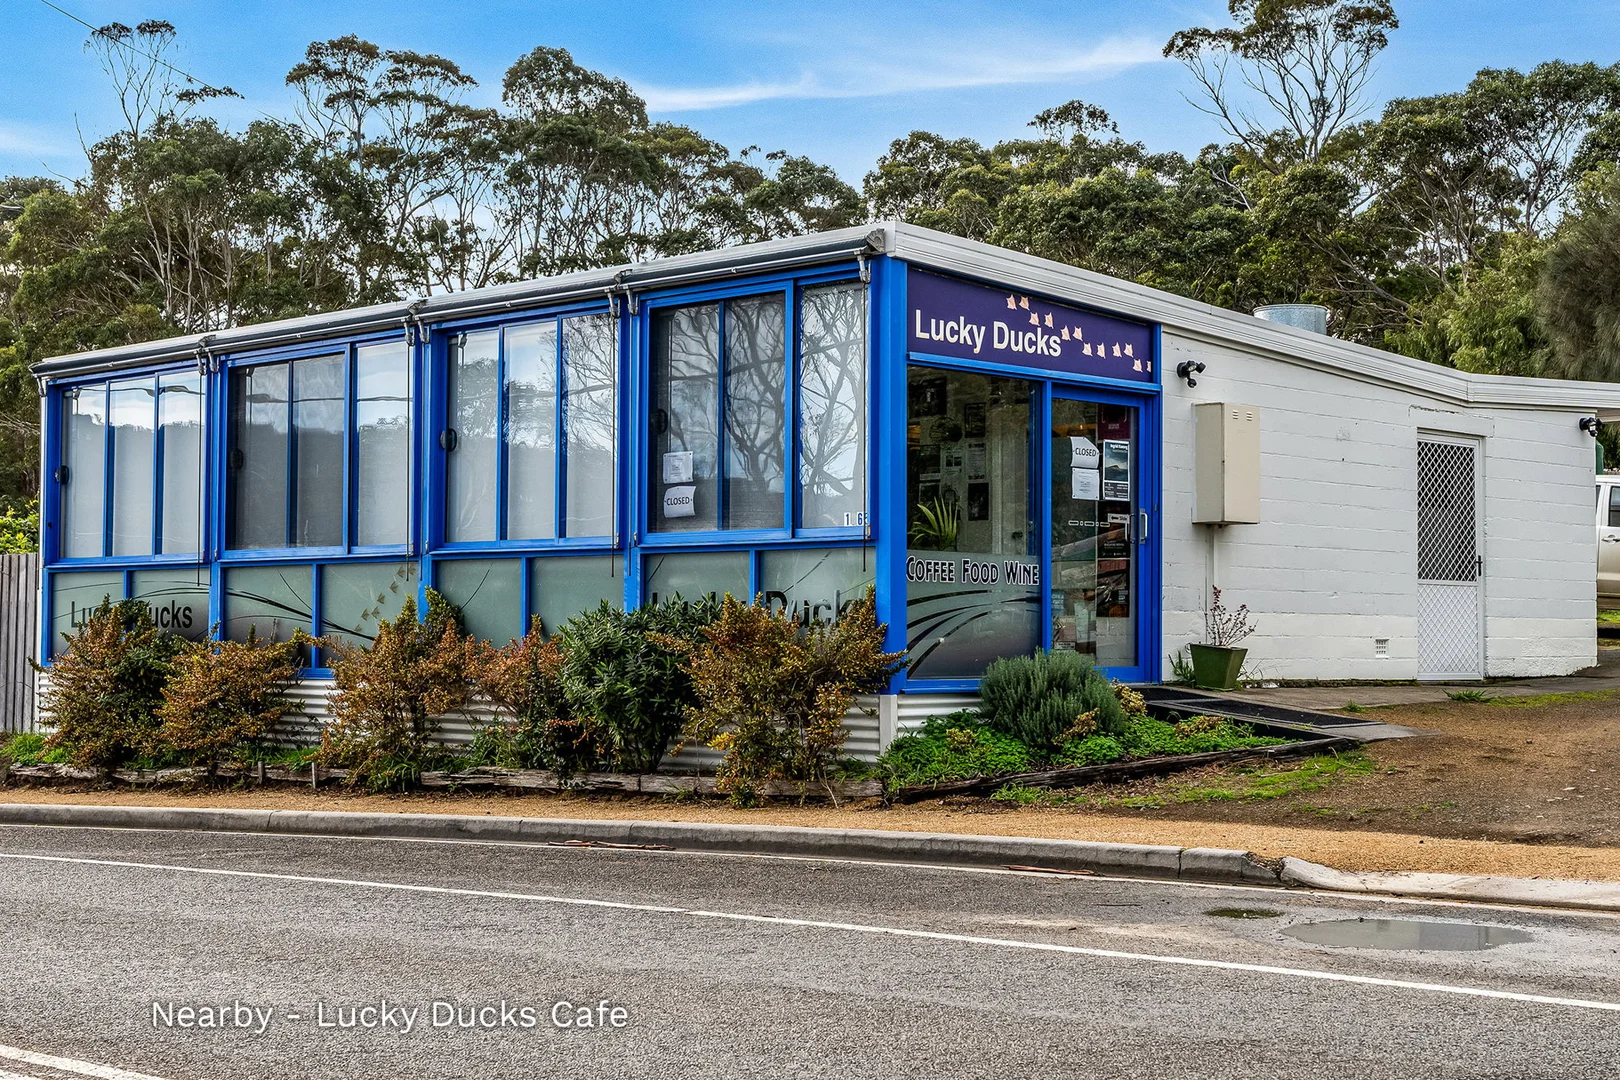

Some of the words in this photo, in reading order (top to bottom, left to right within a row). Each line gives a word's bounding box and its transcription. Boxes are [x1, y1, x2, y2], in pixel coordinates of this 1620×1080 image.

[915, 309, 986, 354] Lucky
[993, 320, 1062, 357] Ducks
[1074, 447, 1097, 457] CLOSED
[666, 496, 690, 506] CLOSED
[906, 555, 956, 583] COFFEE
[961, 558, 999, 585] FOOD
[1004, 560, 1040, 586] WINE
[148, 600, 193, 629] ucks
